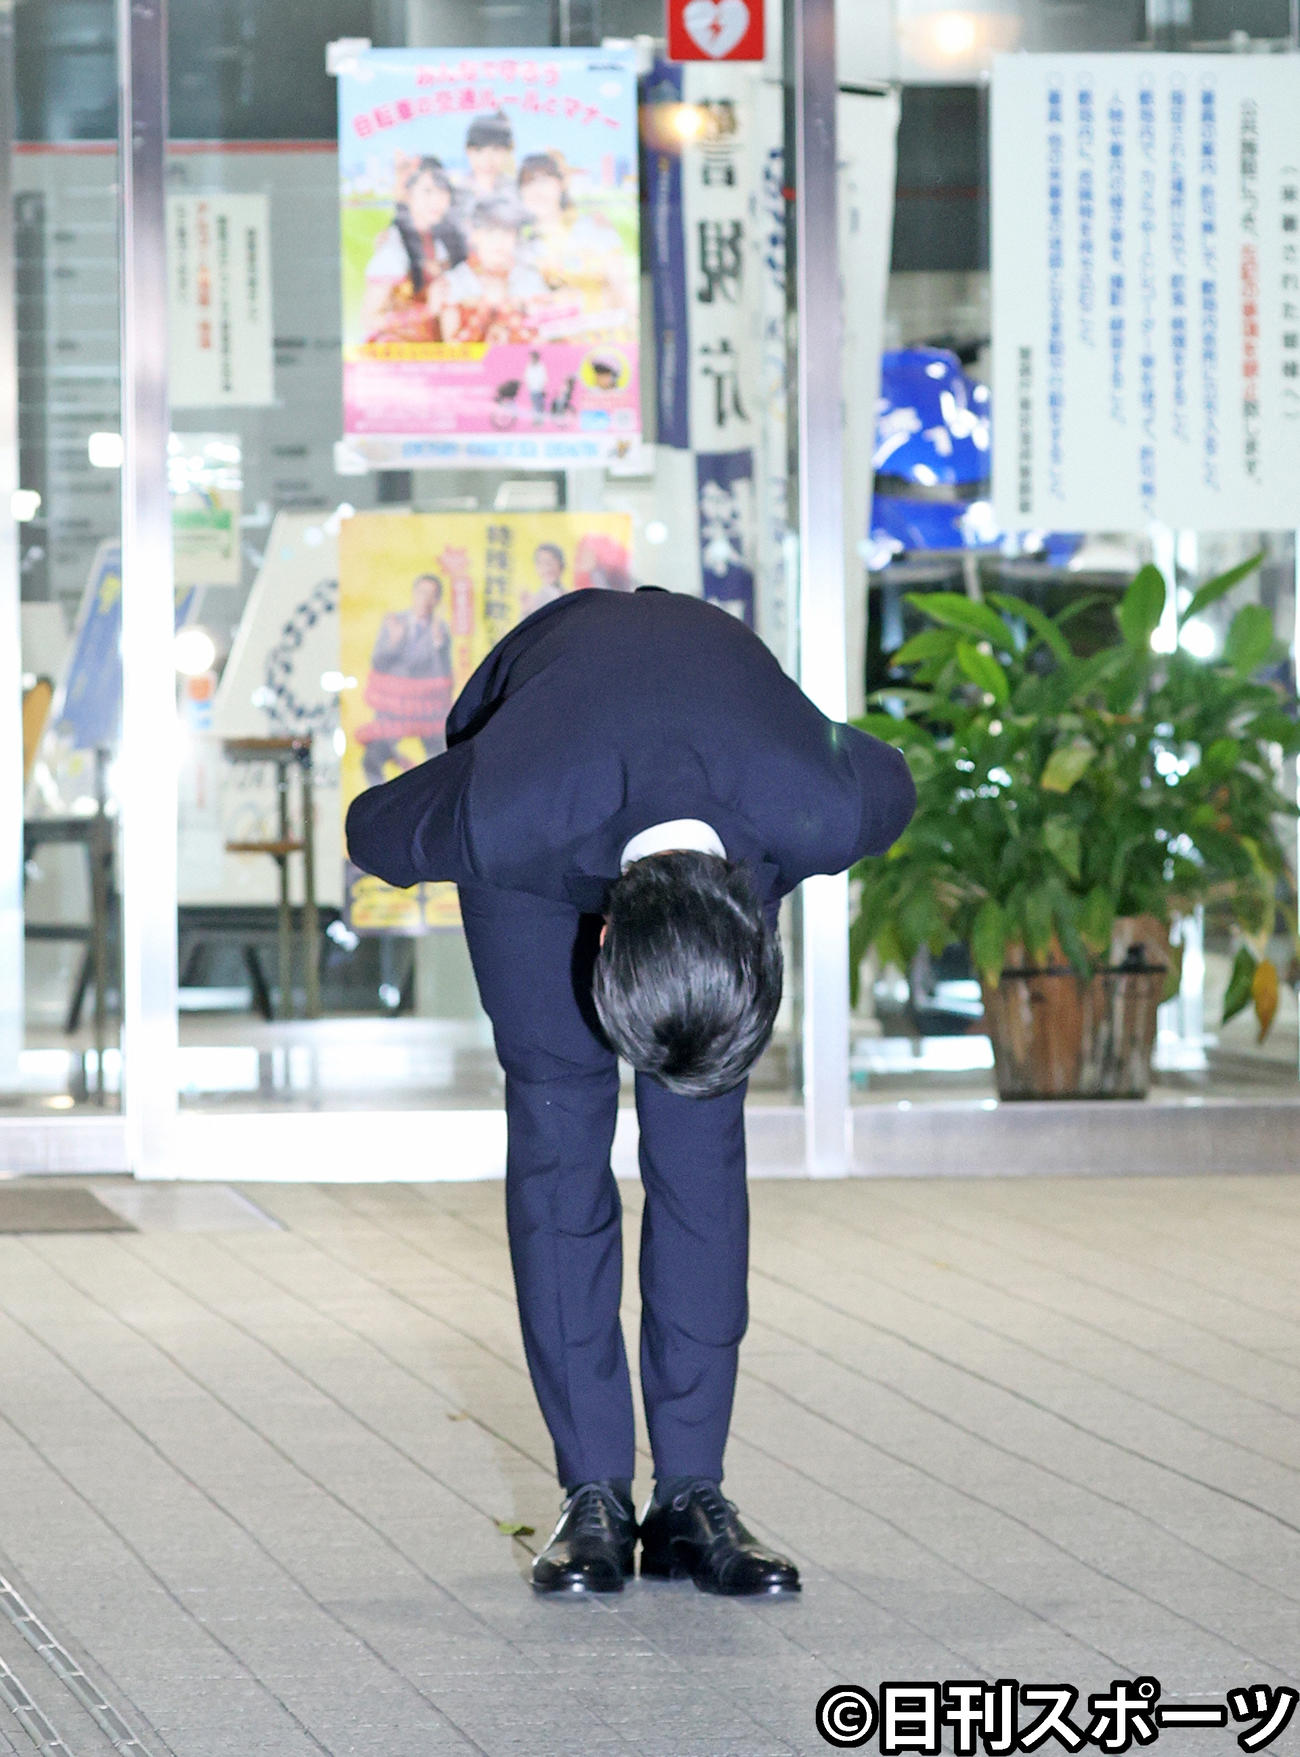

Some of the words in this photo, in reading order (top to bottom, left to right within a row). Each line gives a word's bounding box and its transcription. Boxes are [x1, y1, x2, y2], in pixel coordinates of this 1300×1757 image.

[352, 88, 621, 138] 自転車の交通ルールとマナー
